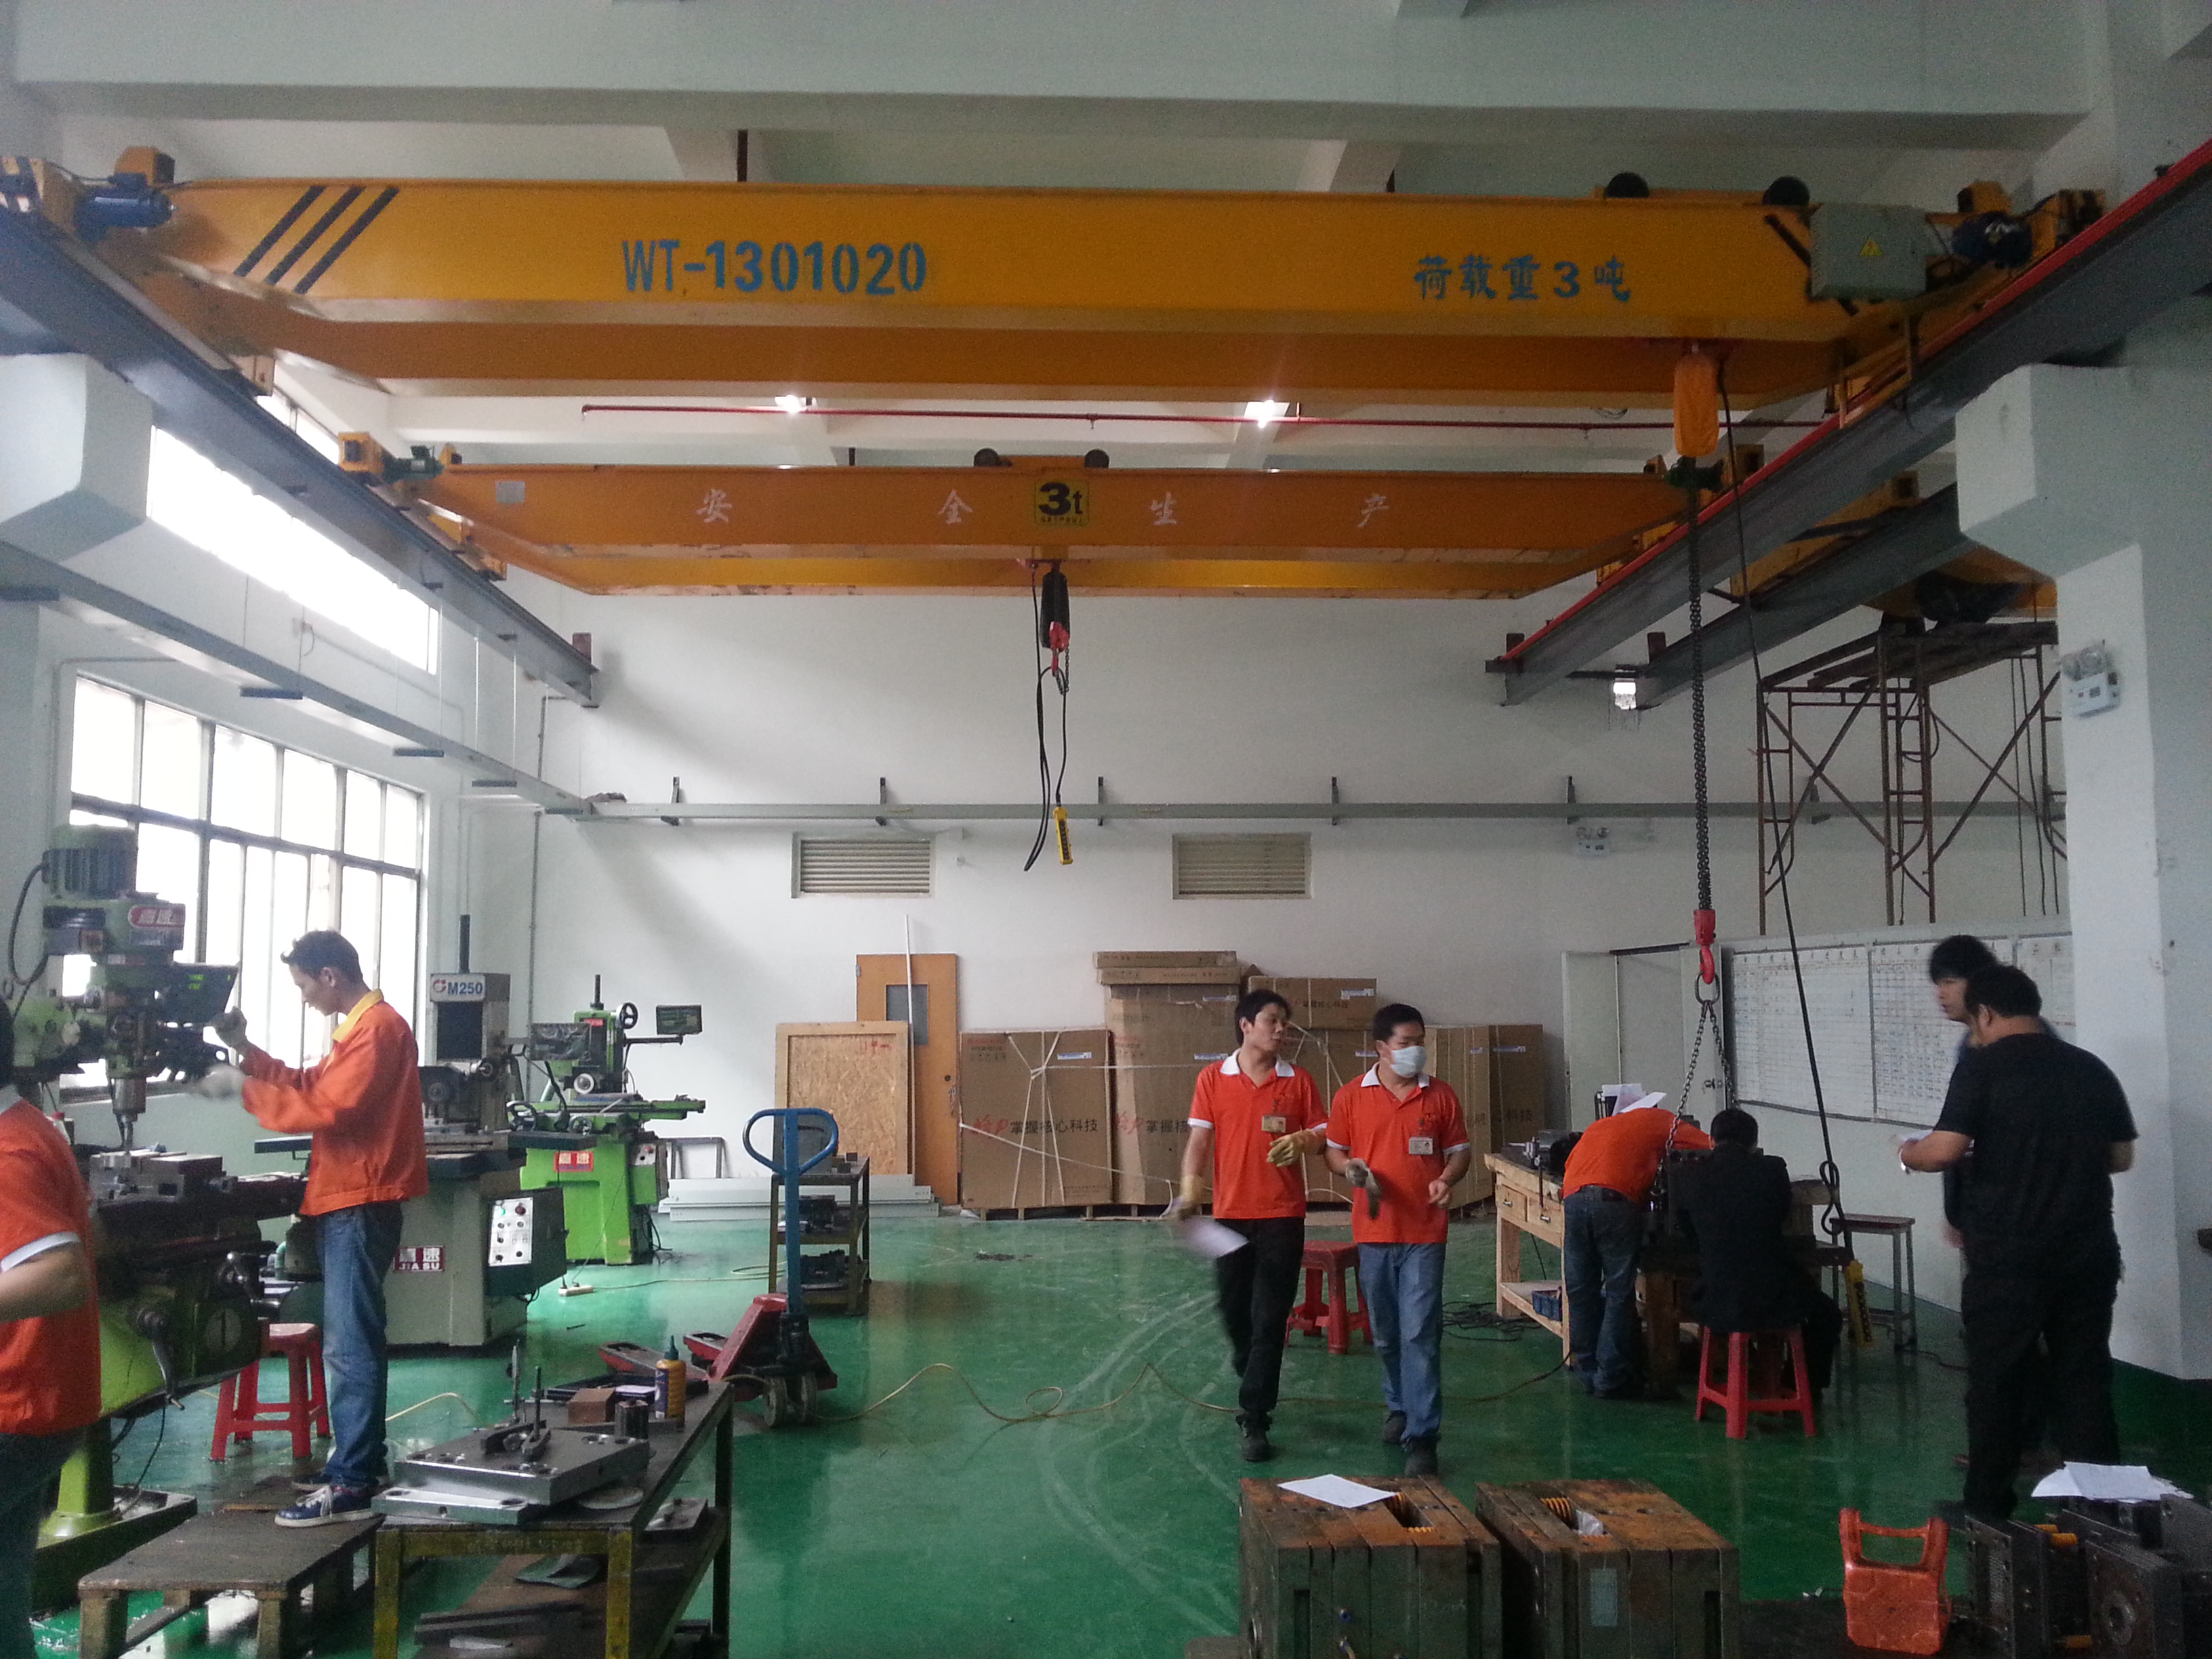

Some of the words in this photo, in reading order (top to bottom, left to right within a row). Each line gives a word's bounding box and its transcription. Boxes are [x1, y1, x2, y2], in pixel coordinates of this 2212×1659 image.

[622, 239, 927, 295] WT-1301020
[1038, 481, 1084, 516] 3t
[447, 981, 483, 995] M250
